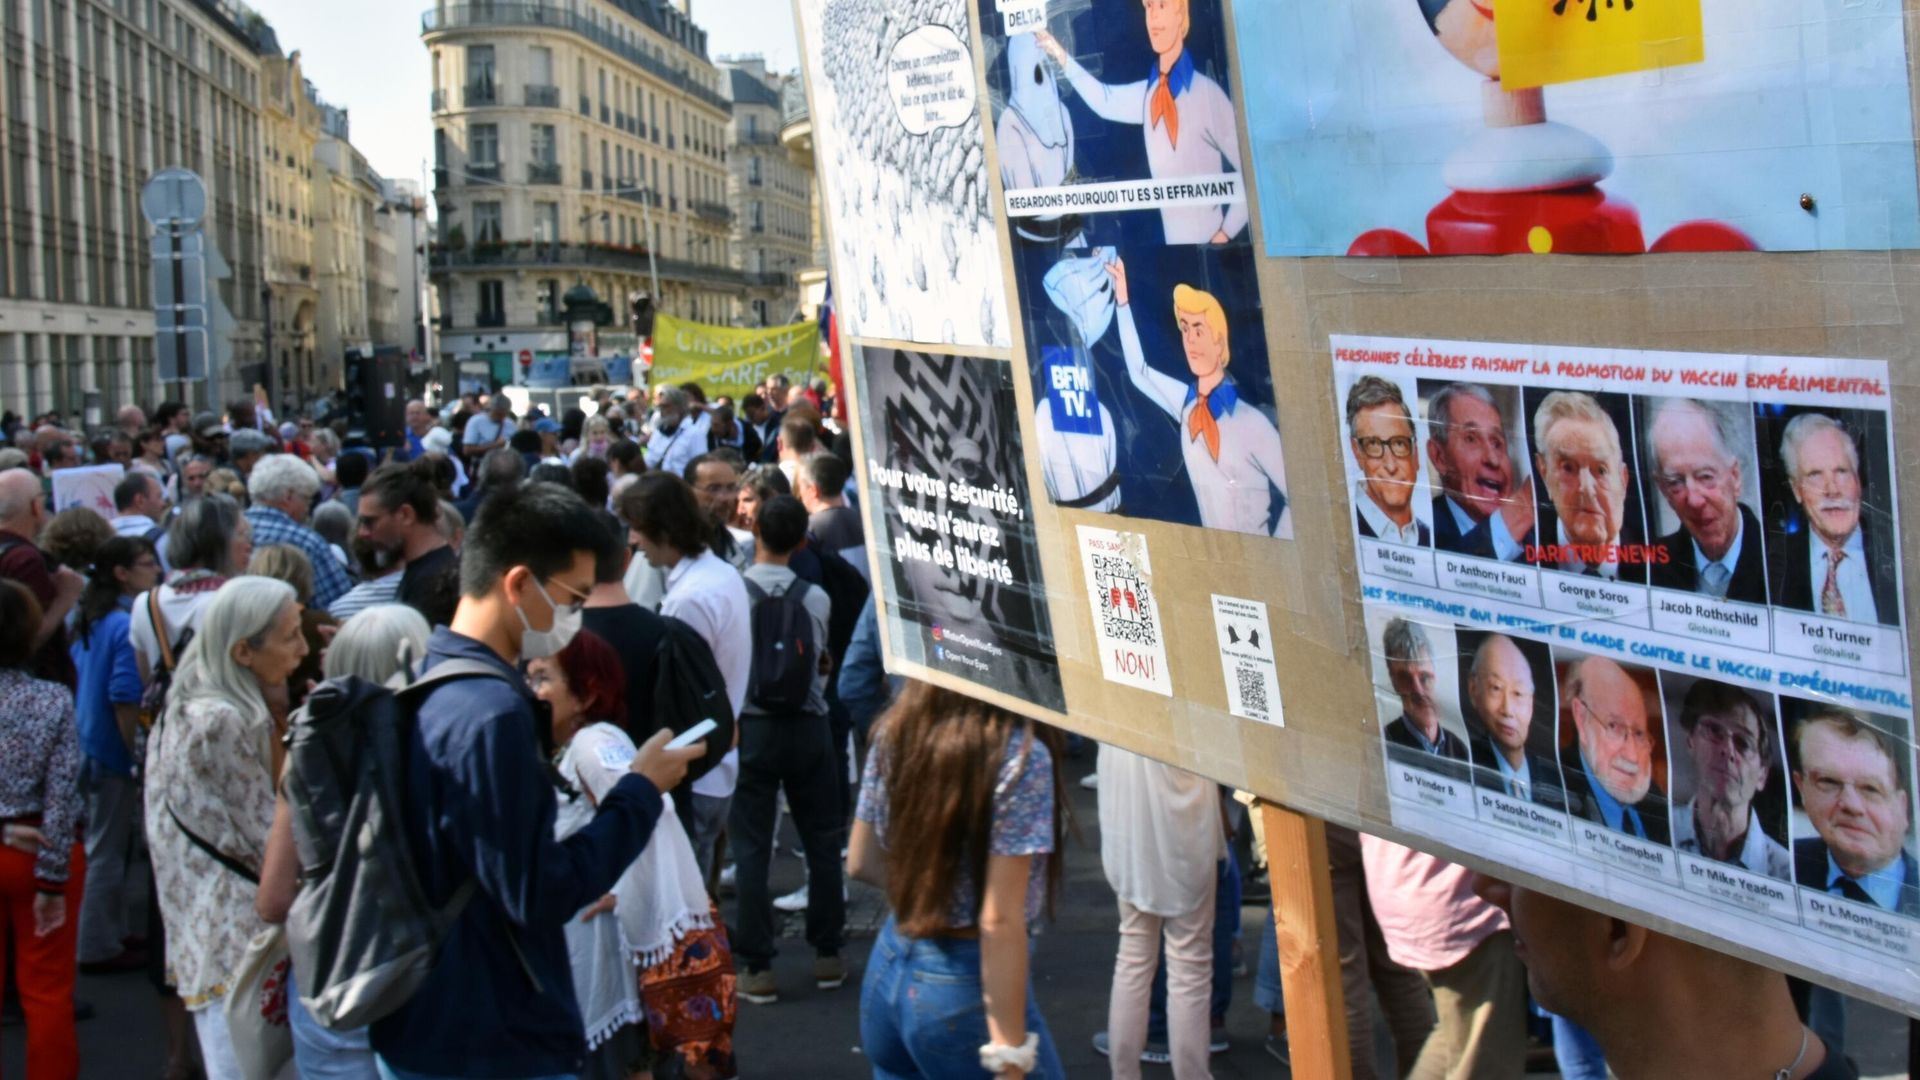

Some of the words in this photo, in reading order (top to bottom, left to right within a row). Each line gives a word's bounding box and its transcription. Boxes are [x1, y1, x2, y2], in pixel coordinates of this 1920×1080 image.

[1009, 8, 1042, 27] DELTA
[1009, 195, 1064, 209] REGARDONS
[1066, 192, 1119, 206] POURQUOI
[1121, 189, 1135, 202] TU
[1137, 188, 1151, 201] ES
[1153, 186, 1164, 200] SI
[1166, 181, 1235, 200] EFFRAYANT
[1050, 364, 1090, 391] BFM
[1335, 348, 1401, 364] PERSONNES
[1404, 346, 1467, 370] CÉLÈBRES
[1471, 355, 1528, 374] FAISANT
[1532, 359, 1550, 375] LA
[1557, 363, 1645, 381] PROMOTION
[1651, 369, 1671, 383] DU
[1680, 370, 1737, 387] VACCIN
[1745, 366, 1887, 396] EXPÉRIMENTAL
[1059, 389, 1092, 418] TV.
[869, 458, 903, 489] Pour
[904, 471, 948, 501] votre
[949, 476, 1025, 521] sécurité,
[898, 504, 936, 531] vous
[937, 509, 1001, 548] n'aurez
[894, 536, 931, 562] plus
[932, 544, 955, 570] de
[956, 544, 1014, 586] liberté
[1377, 548, 1391, 560] Bill
[1391, 552, 1416, 566] Gates
[1525, 544, 1670, 565] DARKTRUENEWS
[1447, 561, 1458, 573] Dr
[1460, 564, 1499, 583] Anthony
[1501, 571, 1527, 586] Fauci
[1558, 581, 1597, 600] George
[1599, 588, 1630, 605] Soros
[1660, 599, 1693, 615] Jacob
[1695, 606, 1759, 627] Rothschild
[1469, 607, 1492, 623] QUI
[1558, 625, 1577, 640] EN
[1581, 631, 1626, 652] GARDE
[1630, 641, 1686, 664] CONTRE
[1692, 653, 1711, 669] LE
[1717, 658, 1772, 682] VACCIN
[1687, 622, 1731, 639] Globalista
[1799, 622, 1825, 639] Ted
[1827, 629, 1873, 647] Turner
[1114, 649, 1156, 681] NON!
[1812, 643, 1862, 662] Globalista
[1403, 772, 1413, 783] Dr
[1447, 785, 1457, 797] B.
[1482, 795, 1493, 808] Dr
[1495, 798, 1529, 818] Satoshi
[1530, 810, 1562, 829] Omura
[1585, 829, 1597, 841] Dr
[1599, 832, 1614, 846] W.
[1614, 839, 1663, 864] Campbell
[1690, 863, 1703, 876] Dr
[1706, 868, 1736, 888] Mike
[1738, 877, 1784, 901] Yeadon
[1810, 898, 1825, 913] Dr
